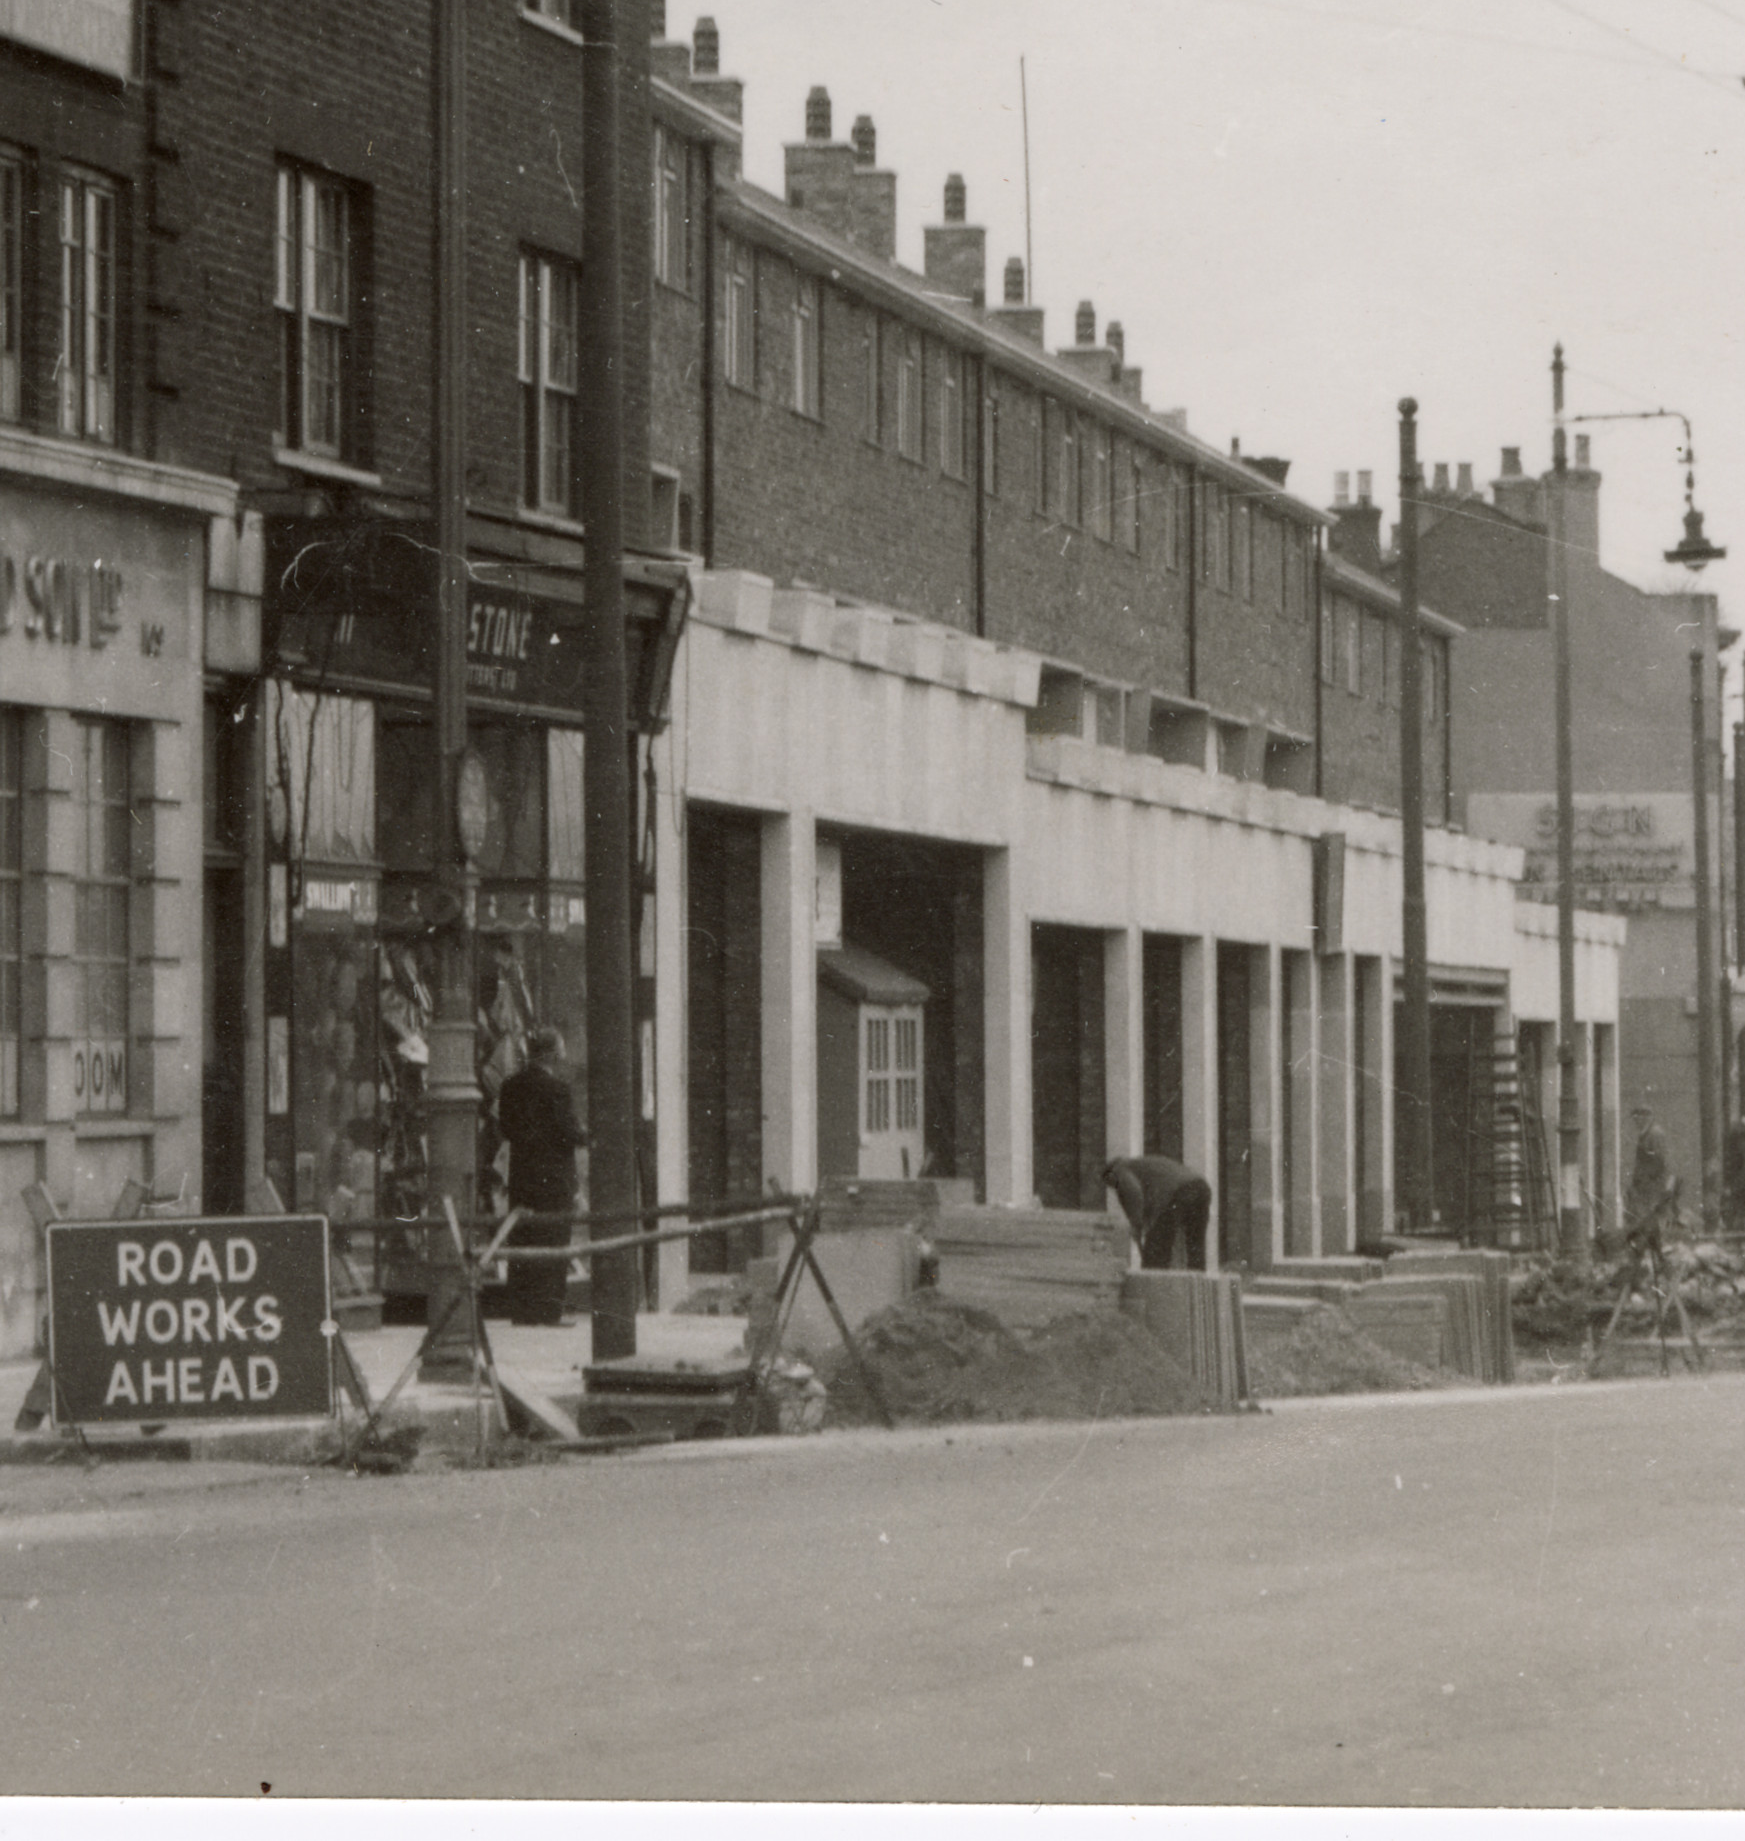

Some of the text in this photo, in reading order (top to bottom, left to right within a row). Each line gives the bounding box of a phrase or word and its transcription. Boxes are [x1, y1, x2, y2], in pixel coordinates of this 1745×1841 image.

[117, 1236, 258, 1287] ROAD
[97, 1293, 283, 1347] WORKS
[104, 1355, 280, 1406] AHEAD
